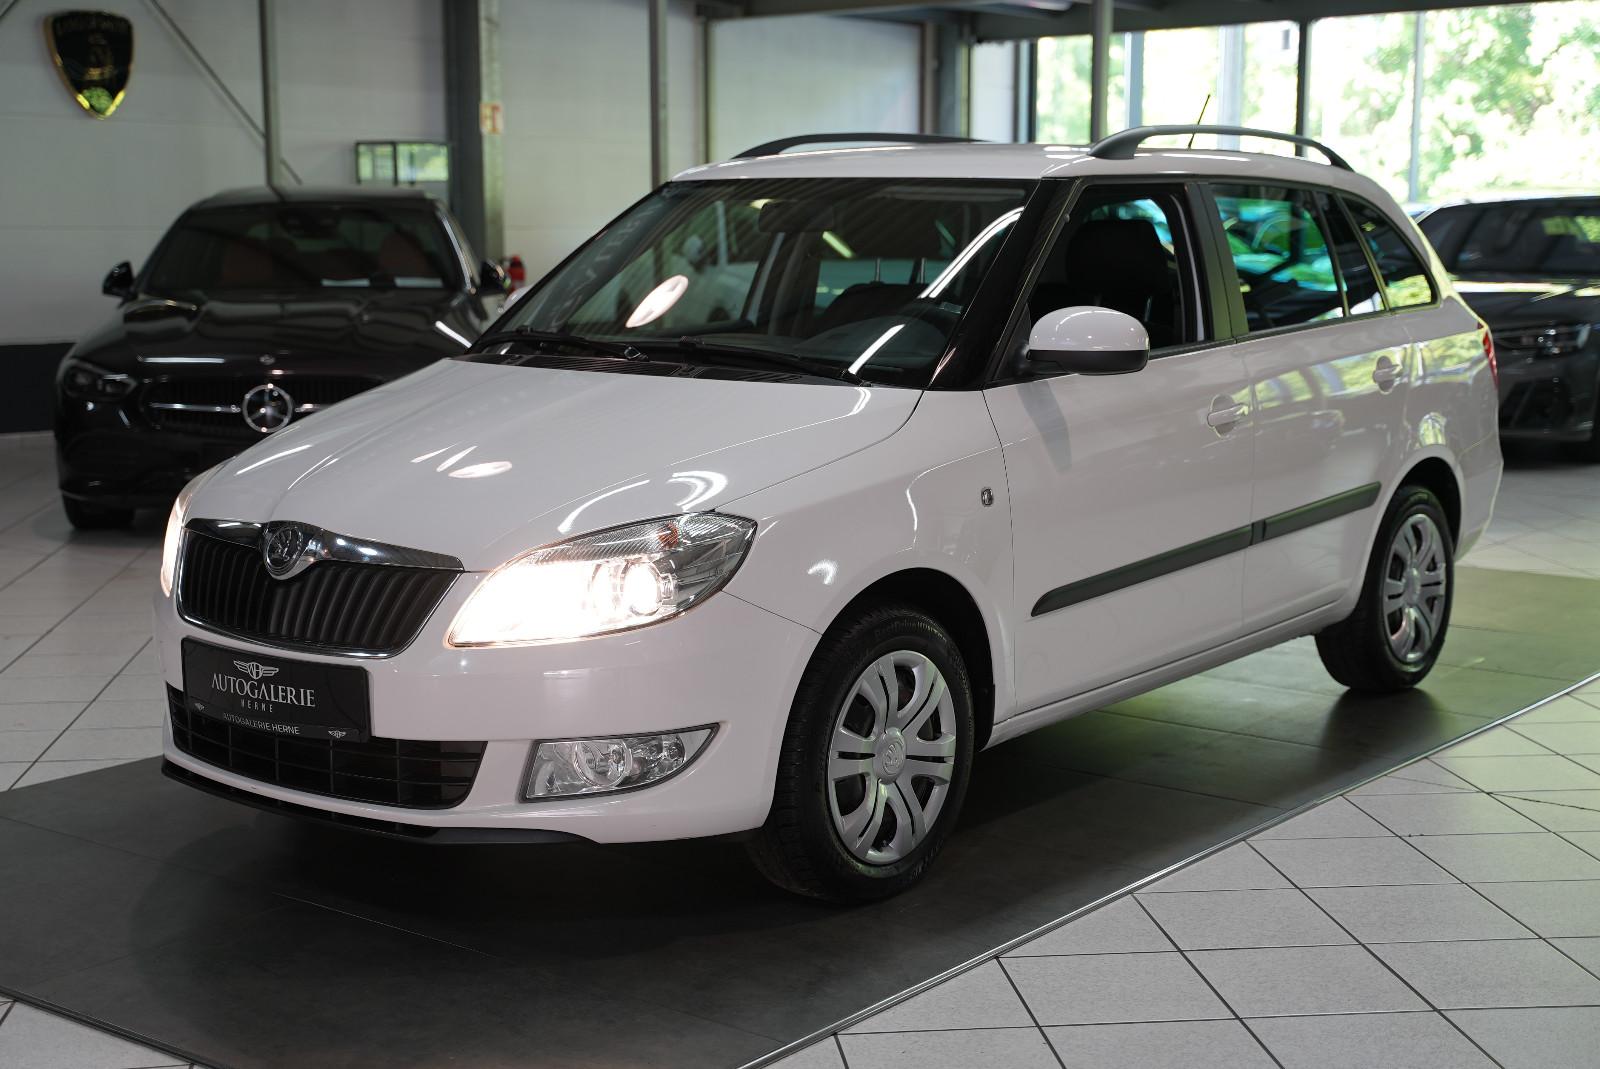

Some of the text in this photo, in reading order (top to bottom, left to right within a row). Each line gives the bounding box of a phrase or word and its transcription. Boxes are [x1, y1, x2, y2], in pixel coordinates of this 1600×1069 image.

[212, 673, 316, 707] AUTOGALERIE
[240, 699, 273, 713] HERNE
[224, 712, 300, 735] AUTOGALERIE HERNE
